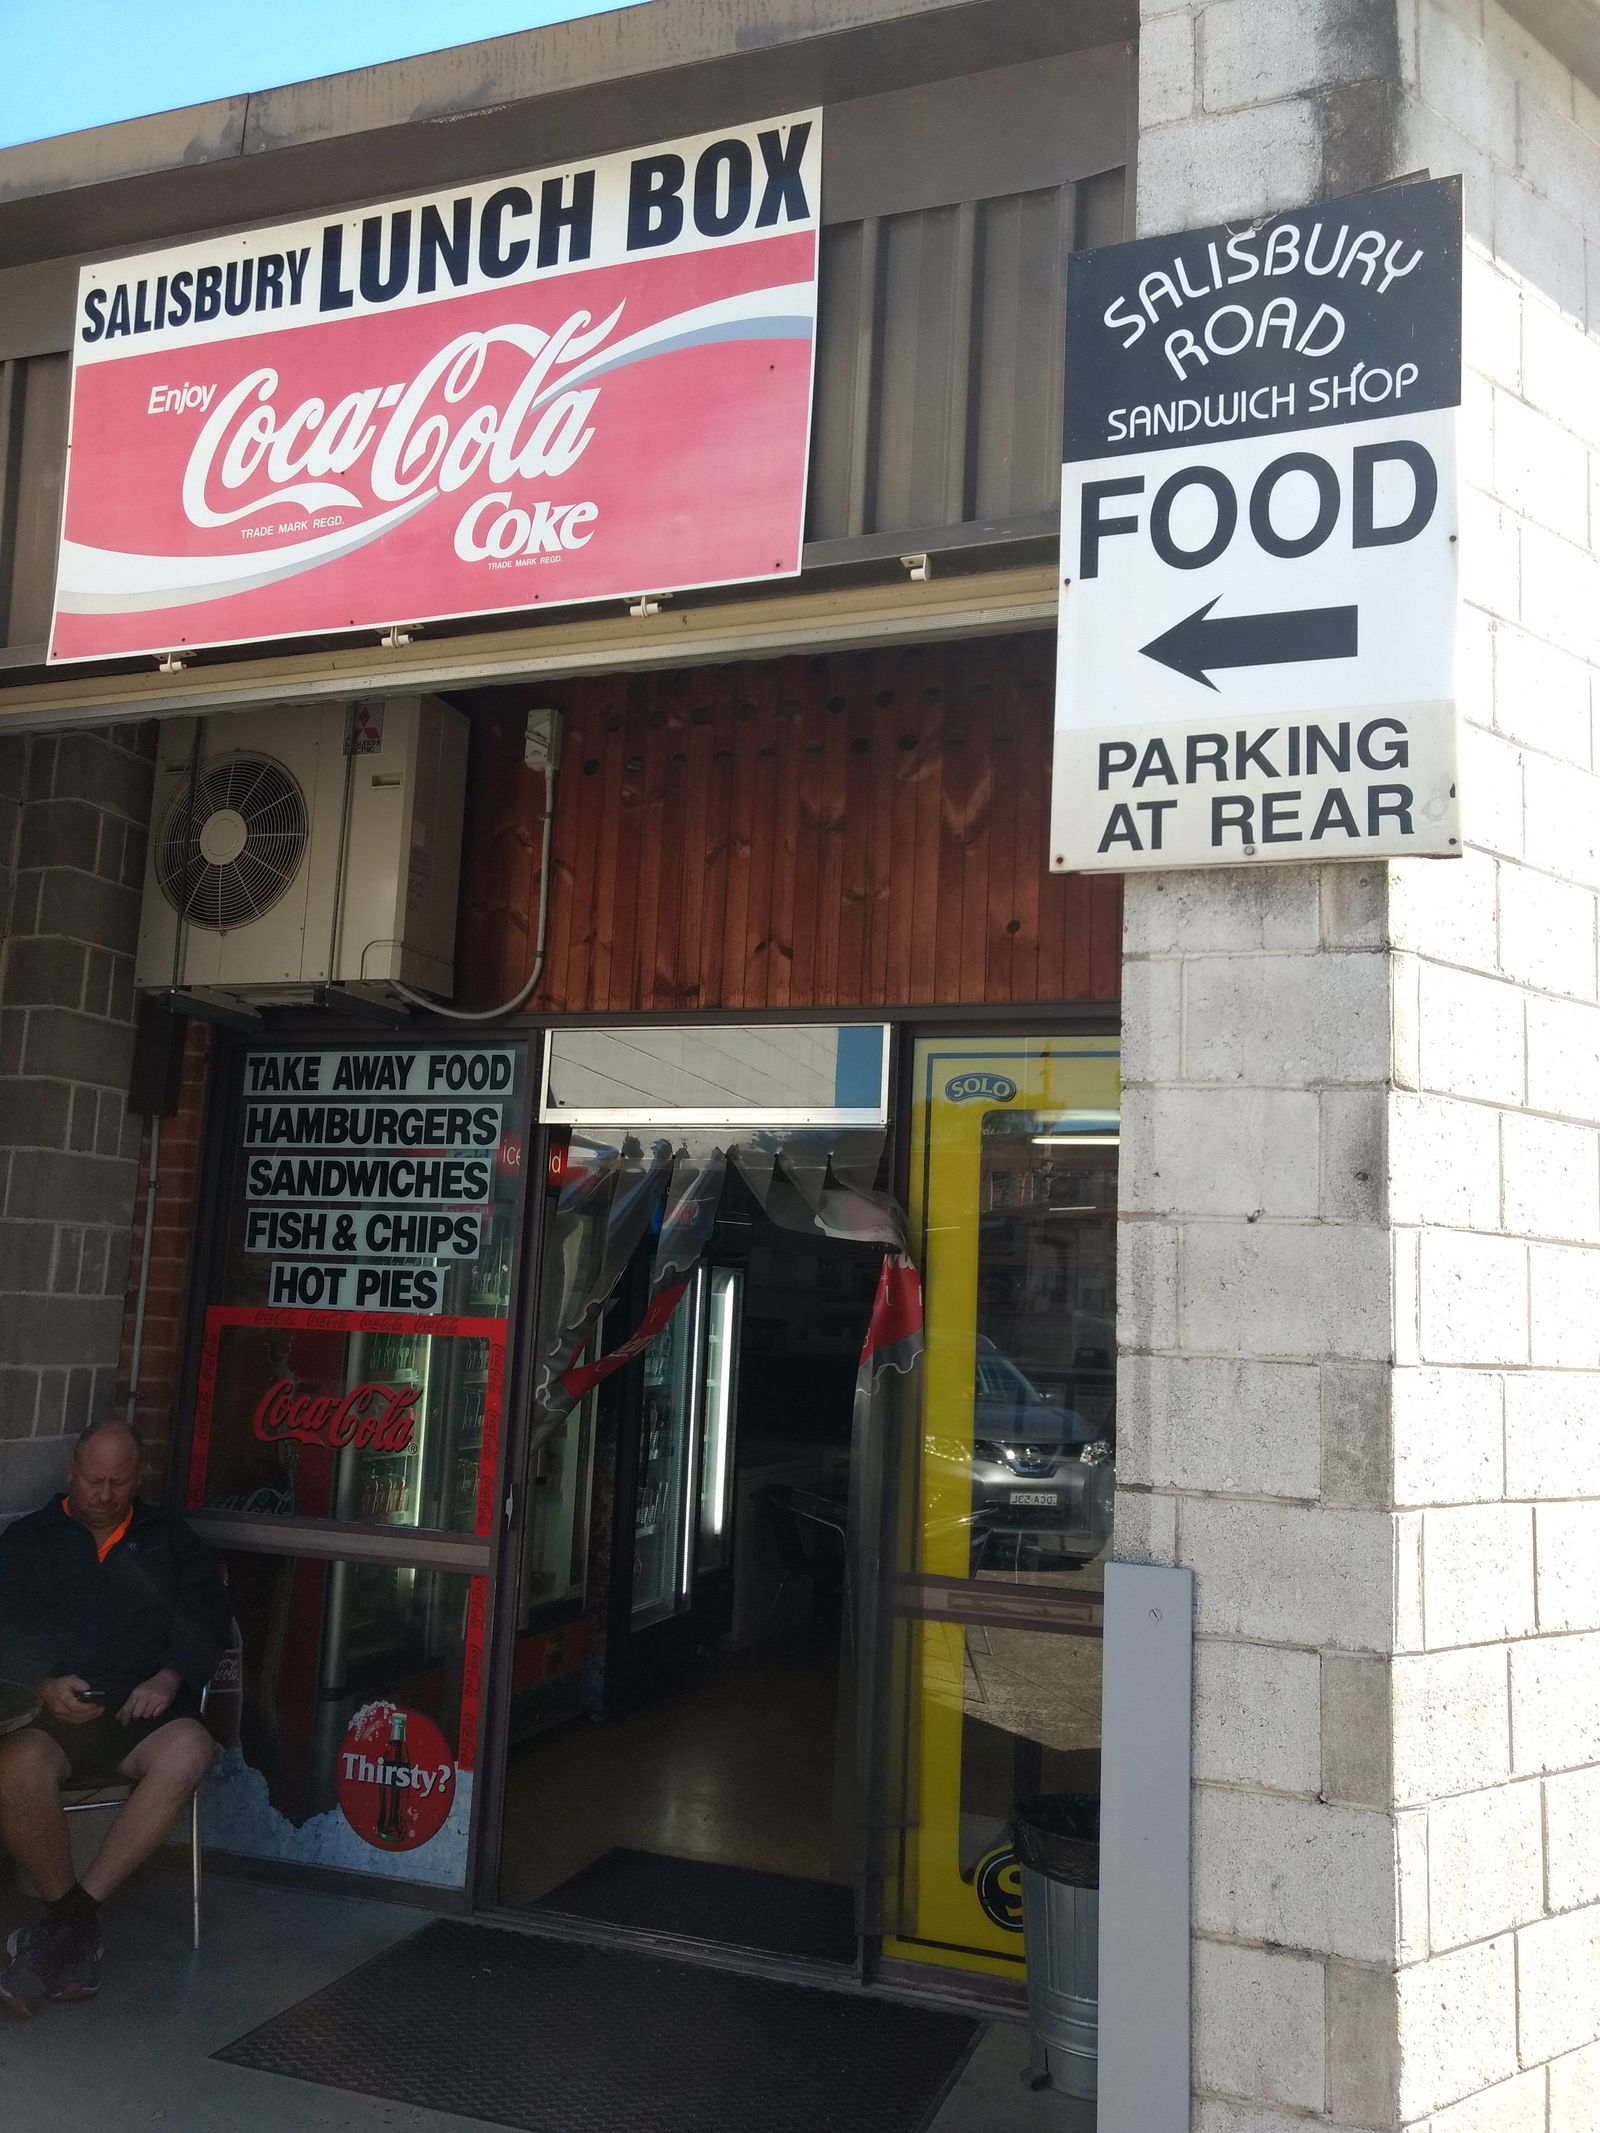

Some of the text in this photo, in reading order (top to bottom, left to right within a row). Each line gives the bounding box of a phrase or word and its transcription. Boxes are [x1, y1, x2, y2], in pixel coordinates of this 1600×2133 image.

[82, 121, 812, 343] SALISBURY LUNCH BOX
[1104, 224, 1423, 349] SALISBURY
[1165, 298, 1345, 381] ROAD
[147, 298, 626, 528] Enjoy Coca-Cola
[1107, 363, 1418, 441] SANDWICH SHOP
[241, 516, 345, 539] TRADE MARK REGD.
[455, 492, 598, 562] Coke
[1079, 440, 1437, 579] FOOD
[488, 555, 562, 570] TRADE MARK REGD.
[1099, 717, 1409, 790] PARKING
[1097, 783, 1414, 853] AT REAR
[248, 1055, 510, 1091] TAKE AWAY FOOD
[952, 1078, 1010, 1097] SOLO
[246, 1107, 497, 1146] HAMBURGERS
[250, 1160, 488, 1199] SANDWICHES
[247, 1212, 478, 1254] FISH & CHIPS
[273, 1267, 437, 1309] HOT PIES
[253, 1378, 425, 1453] Coca-Cola
[343, 1753, 451, 1798] Thirsty?
